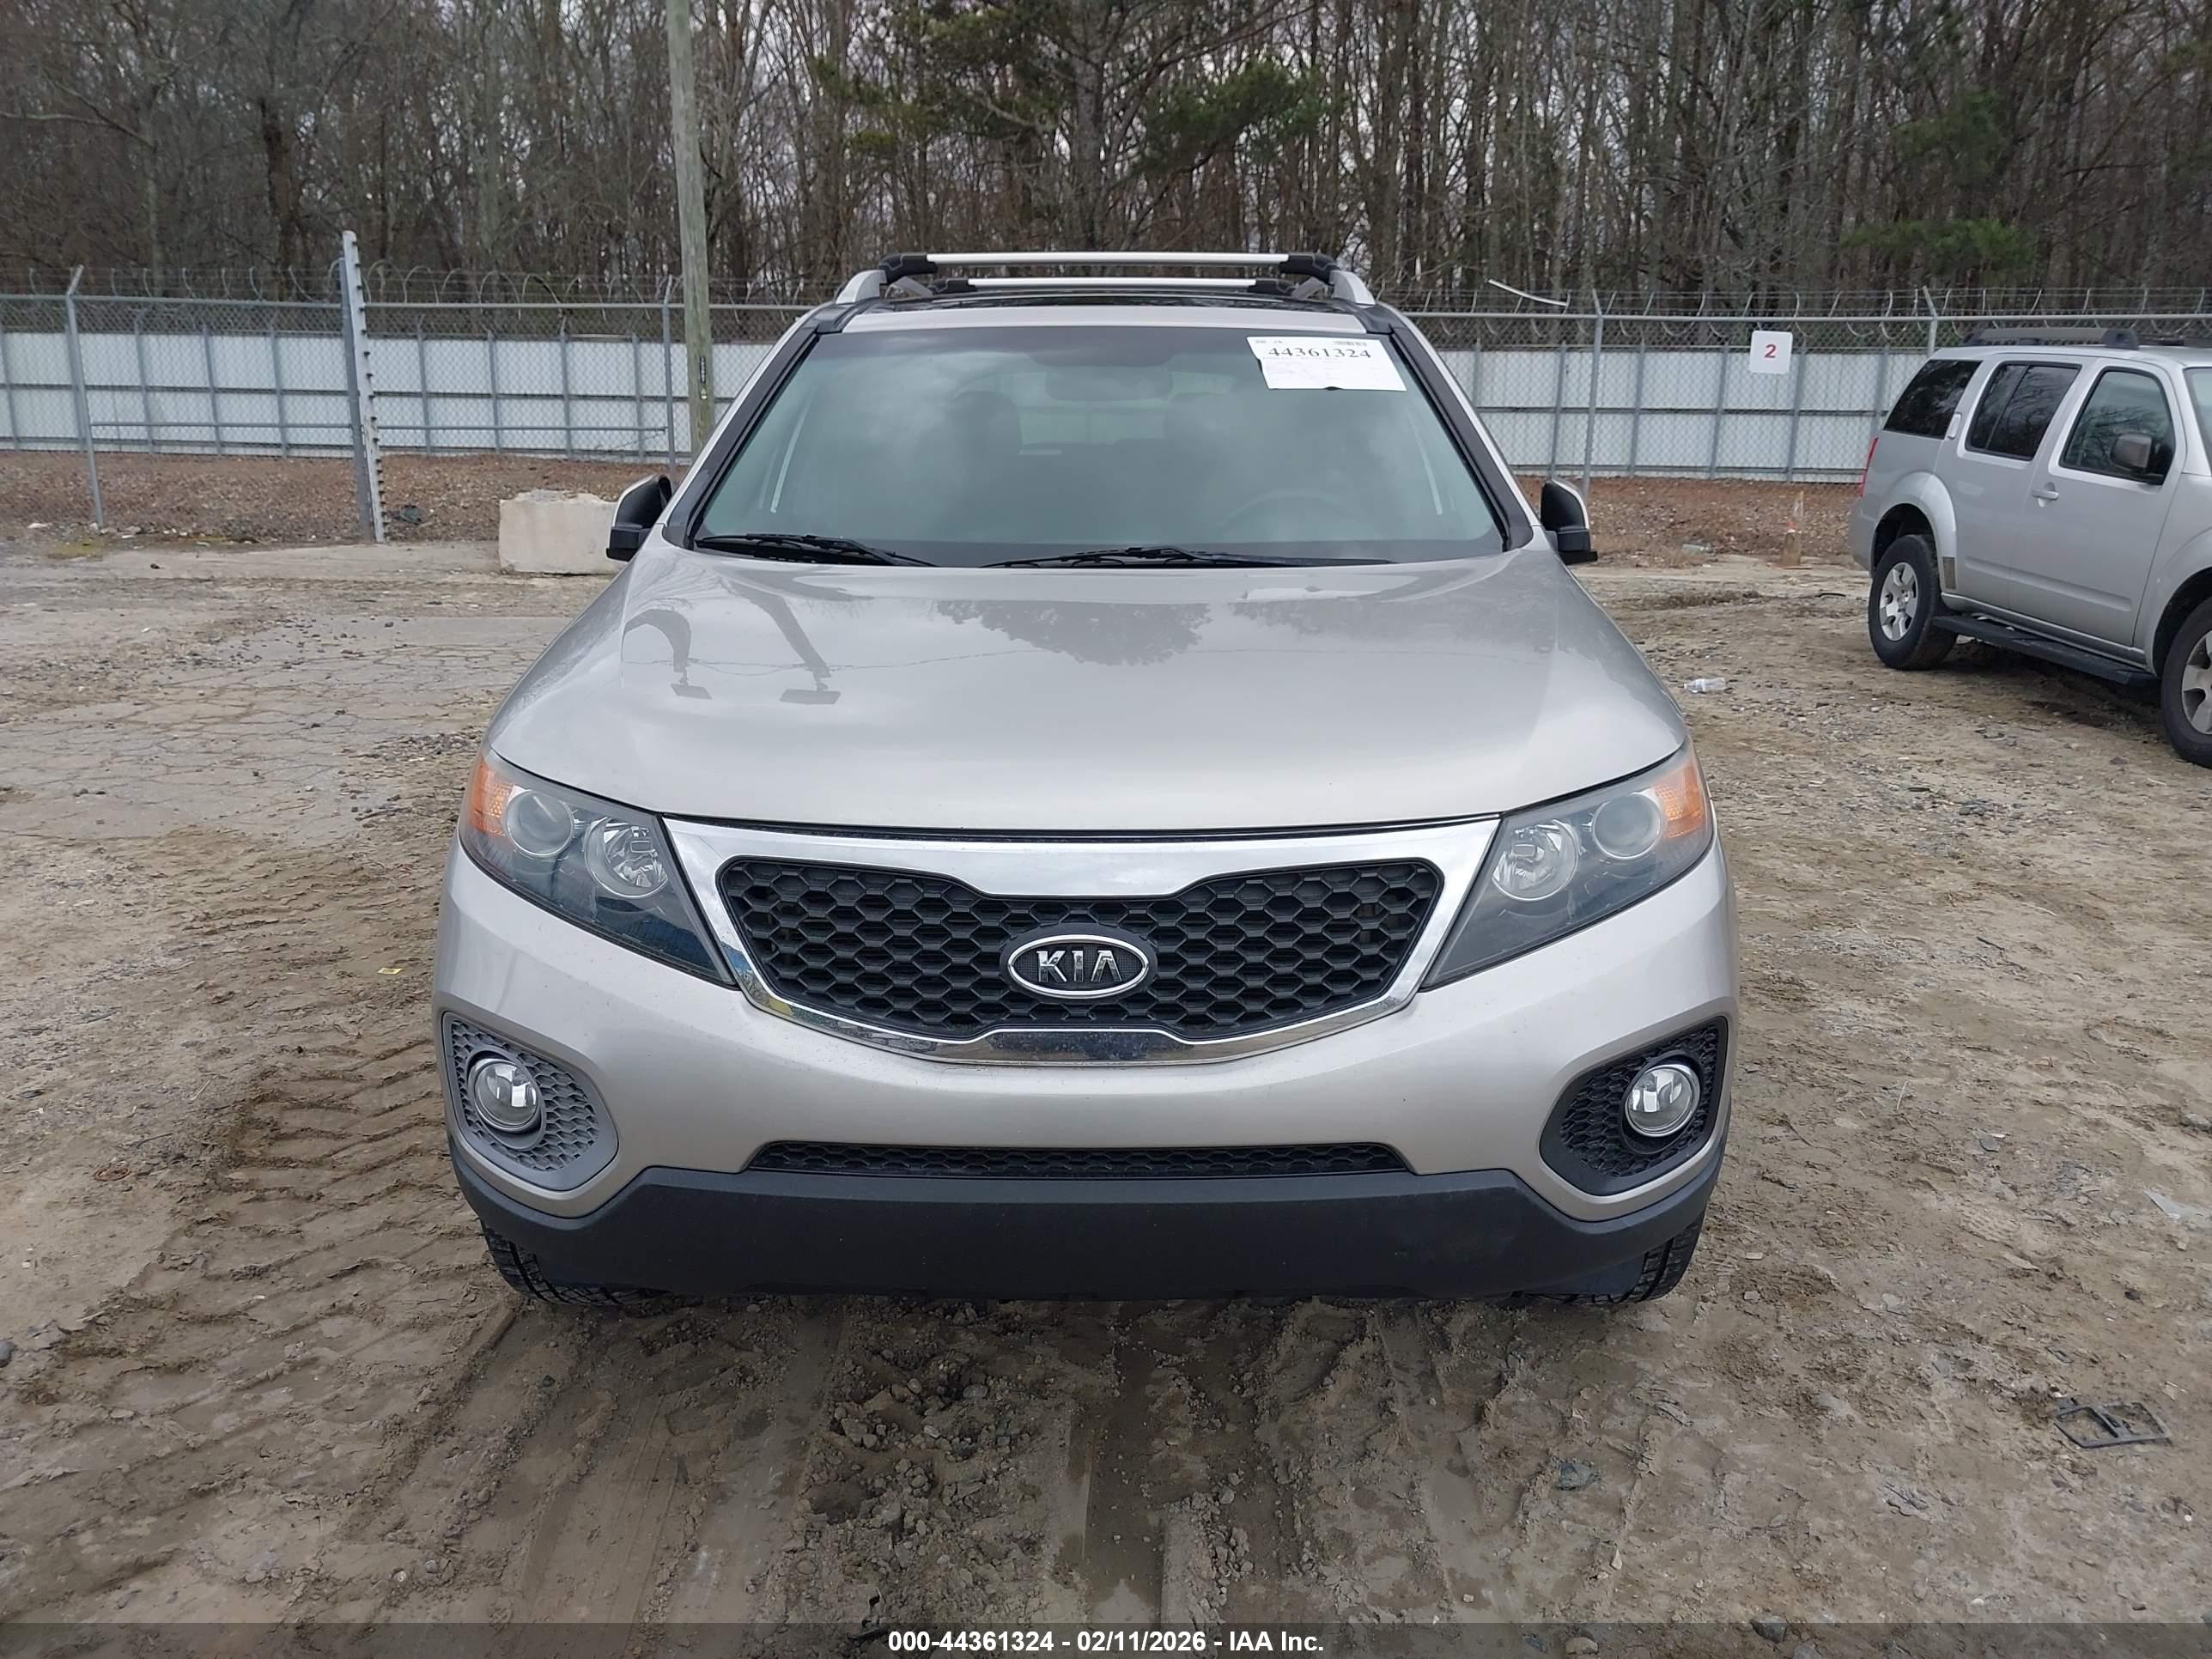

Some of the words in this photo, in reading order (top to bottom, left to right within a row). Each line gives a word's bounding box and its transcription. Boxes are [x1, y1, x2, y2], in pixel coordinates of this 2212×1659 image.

[1267, 347, 1372, 359] 44361324
[1765, 343, 1777, 358] 2
[1036, 950, 1122, 982] KIA
